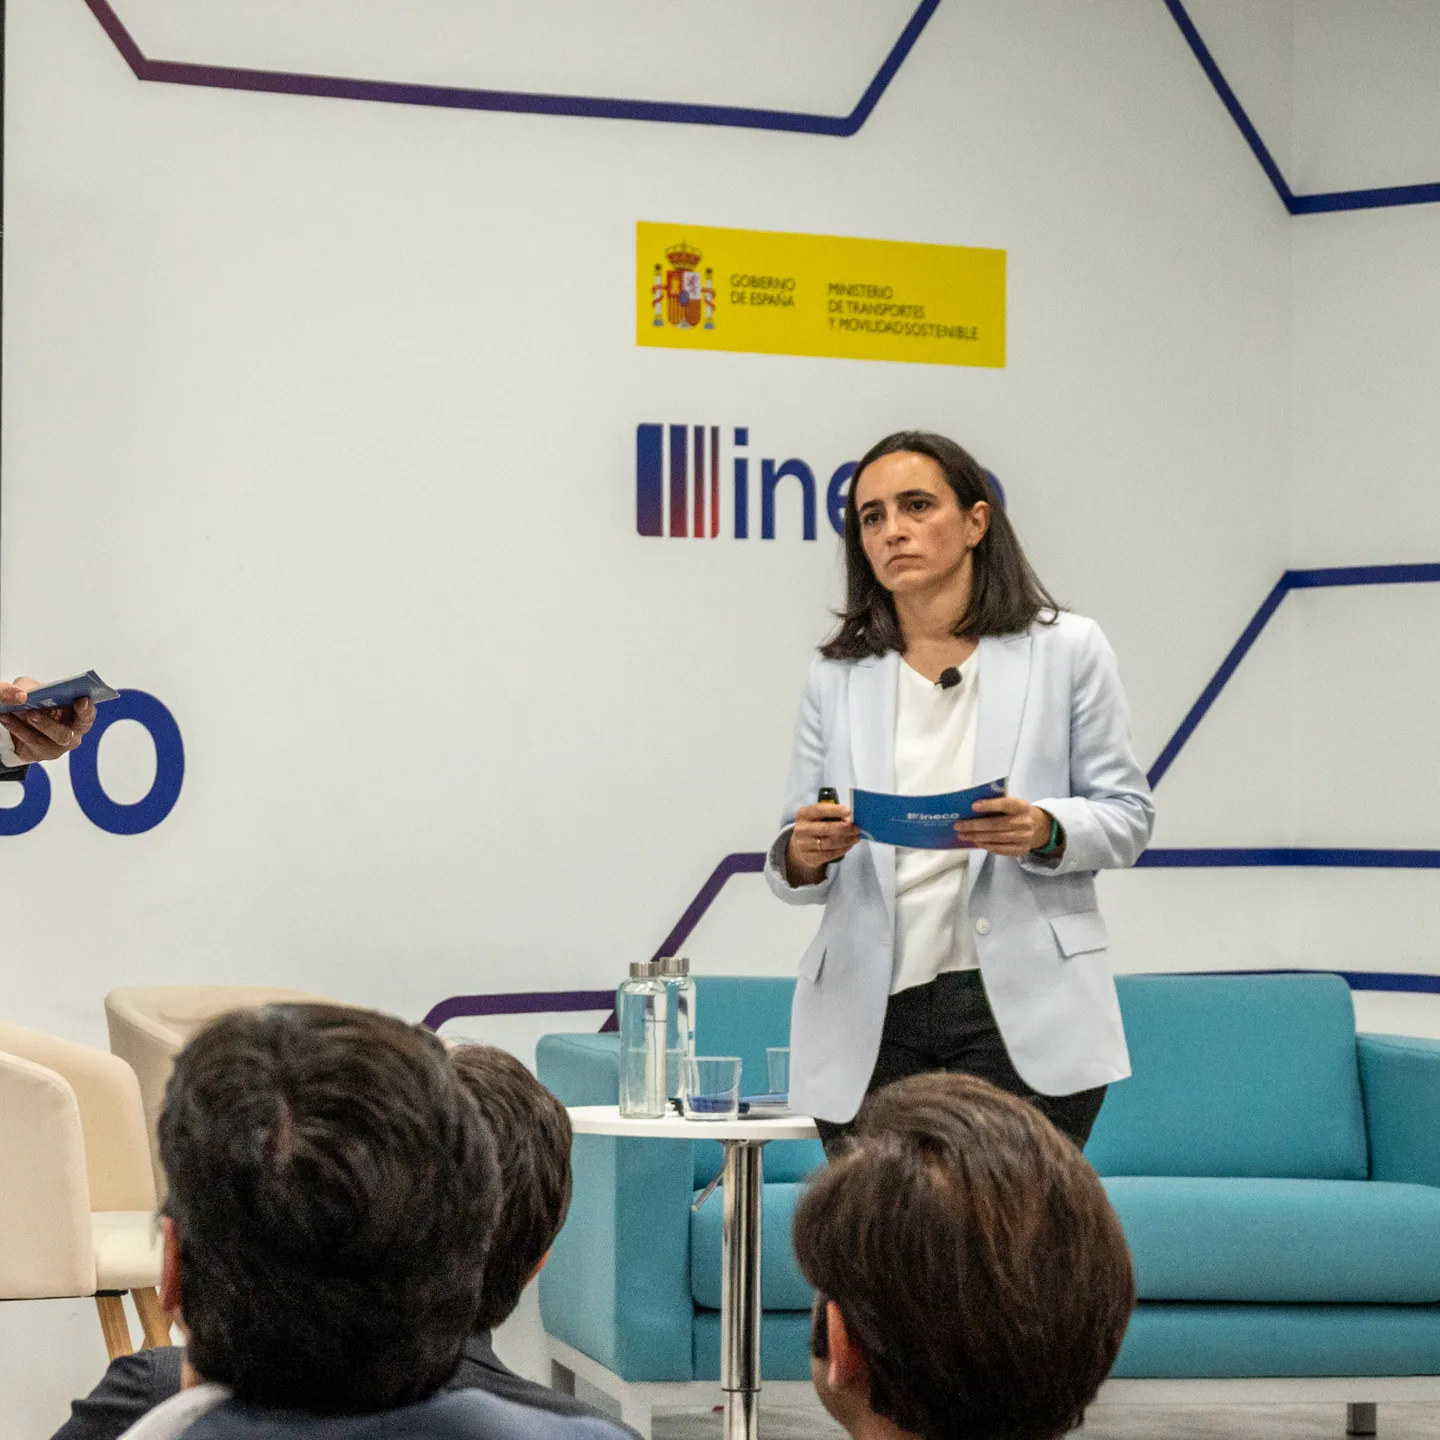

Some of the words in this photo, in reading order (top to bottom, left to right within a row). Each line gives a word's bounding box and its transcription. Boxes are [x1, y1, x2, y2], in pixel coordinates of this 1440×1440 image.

[730, 273, 796, 291] GOBIERNO
[730, 290, 746, 304] DE
[750, 291, 796, 307] ESPAÑA
[827, 283, 894, 299] MINISTERIO
[827, 299, 843, 313] DE
[846, 299, 926, 319] TRANSPORTES
[827, 317, 835, 330] Y
